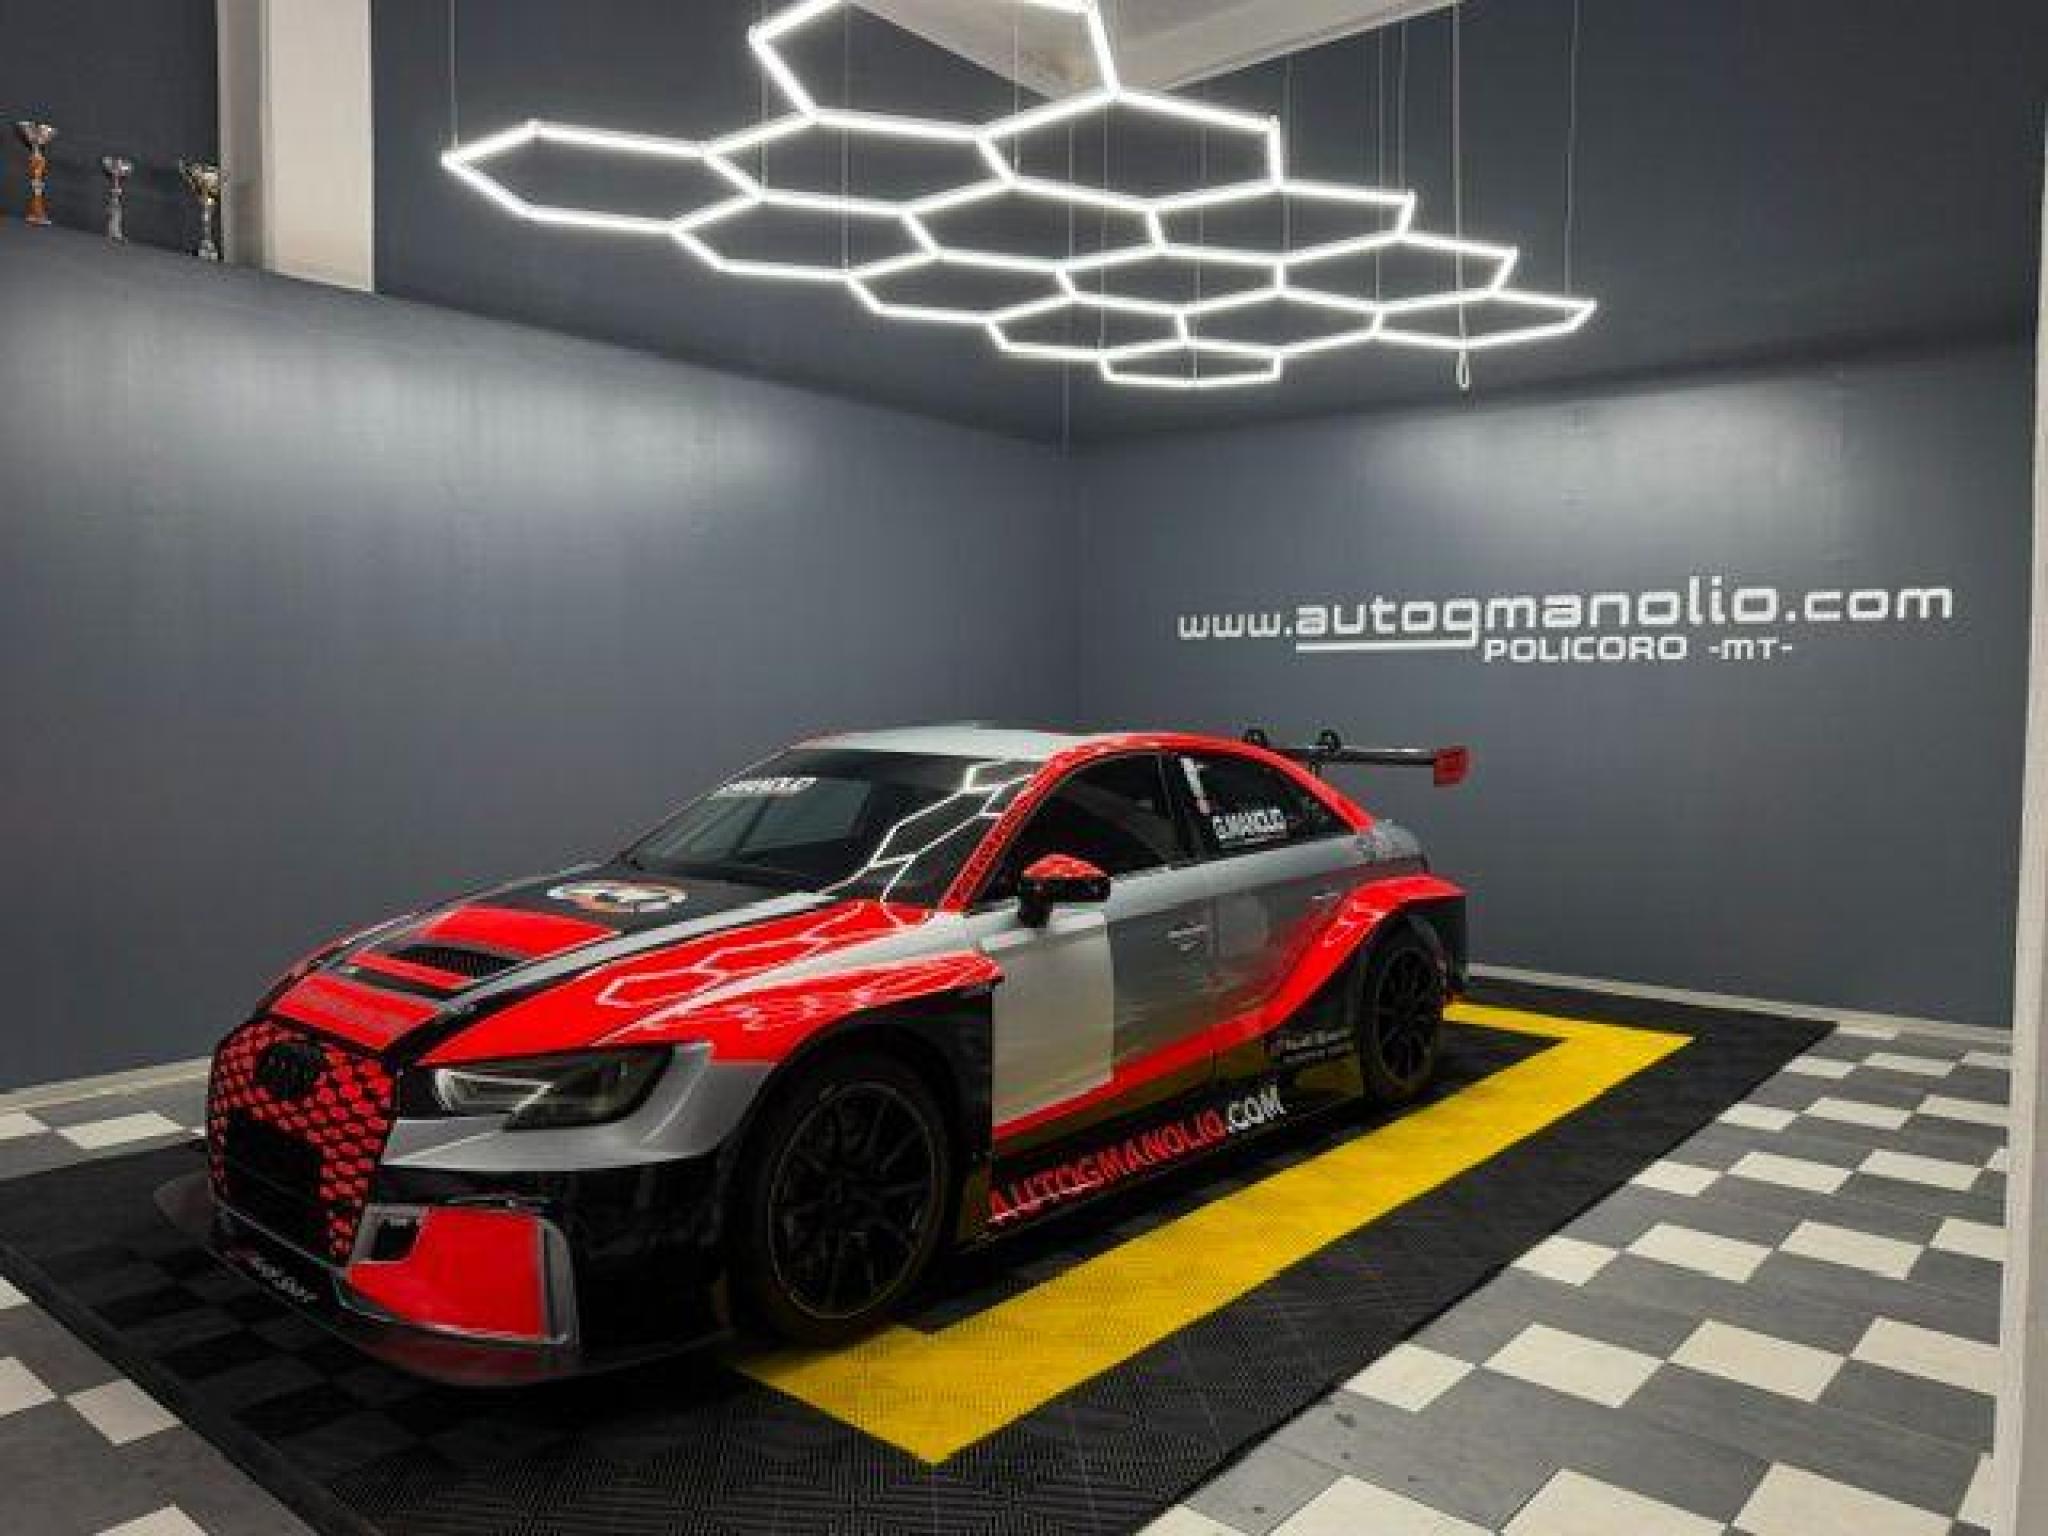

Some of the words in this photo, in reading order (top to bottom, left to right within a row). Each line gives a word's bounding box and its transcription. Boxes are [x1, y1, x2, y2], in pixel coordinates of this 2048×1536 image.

[1179, 575, 1955, 648] www.autogmanolio.com
[1482, 635, 1689, 663] POLICORO
[987, 1084, 1286, 1224] AUTOGMANOLIO.COM
